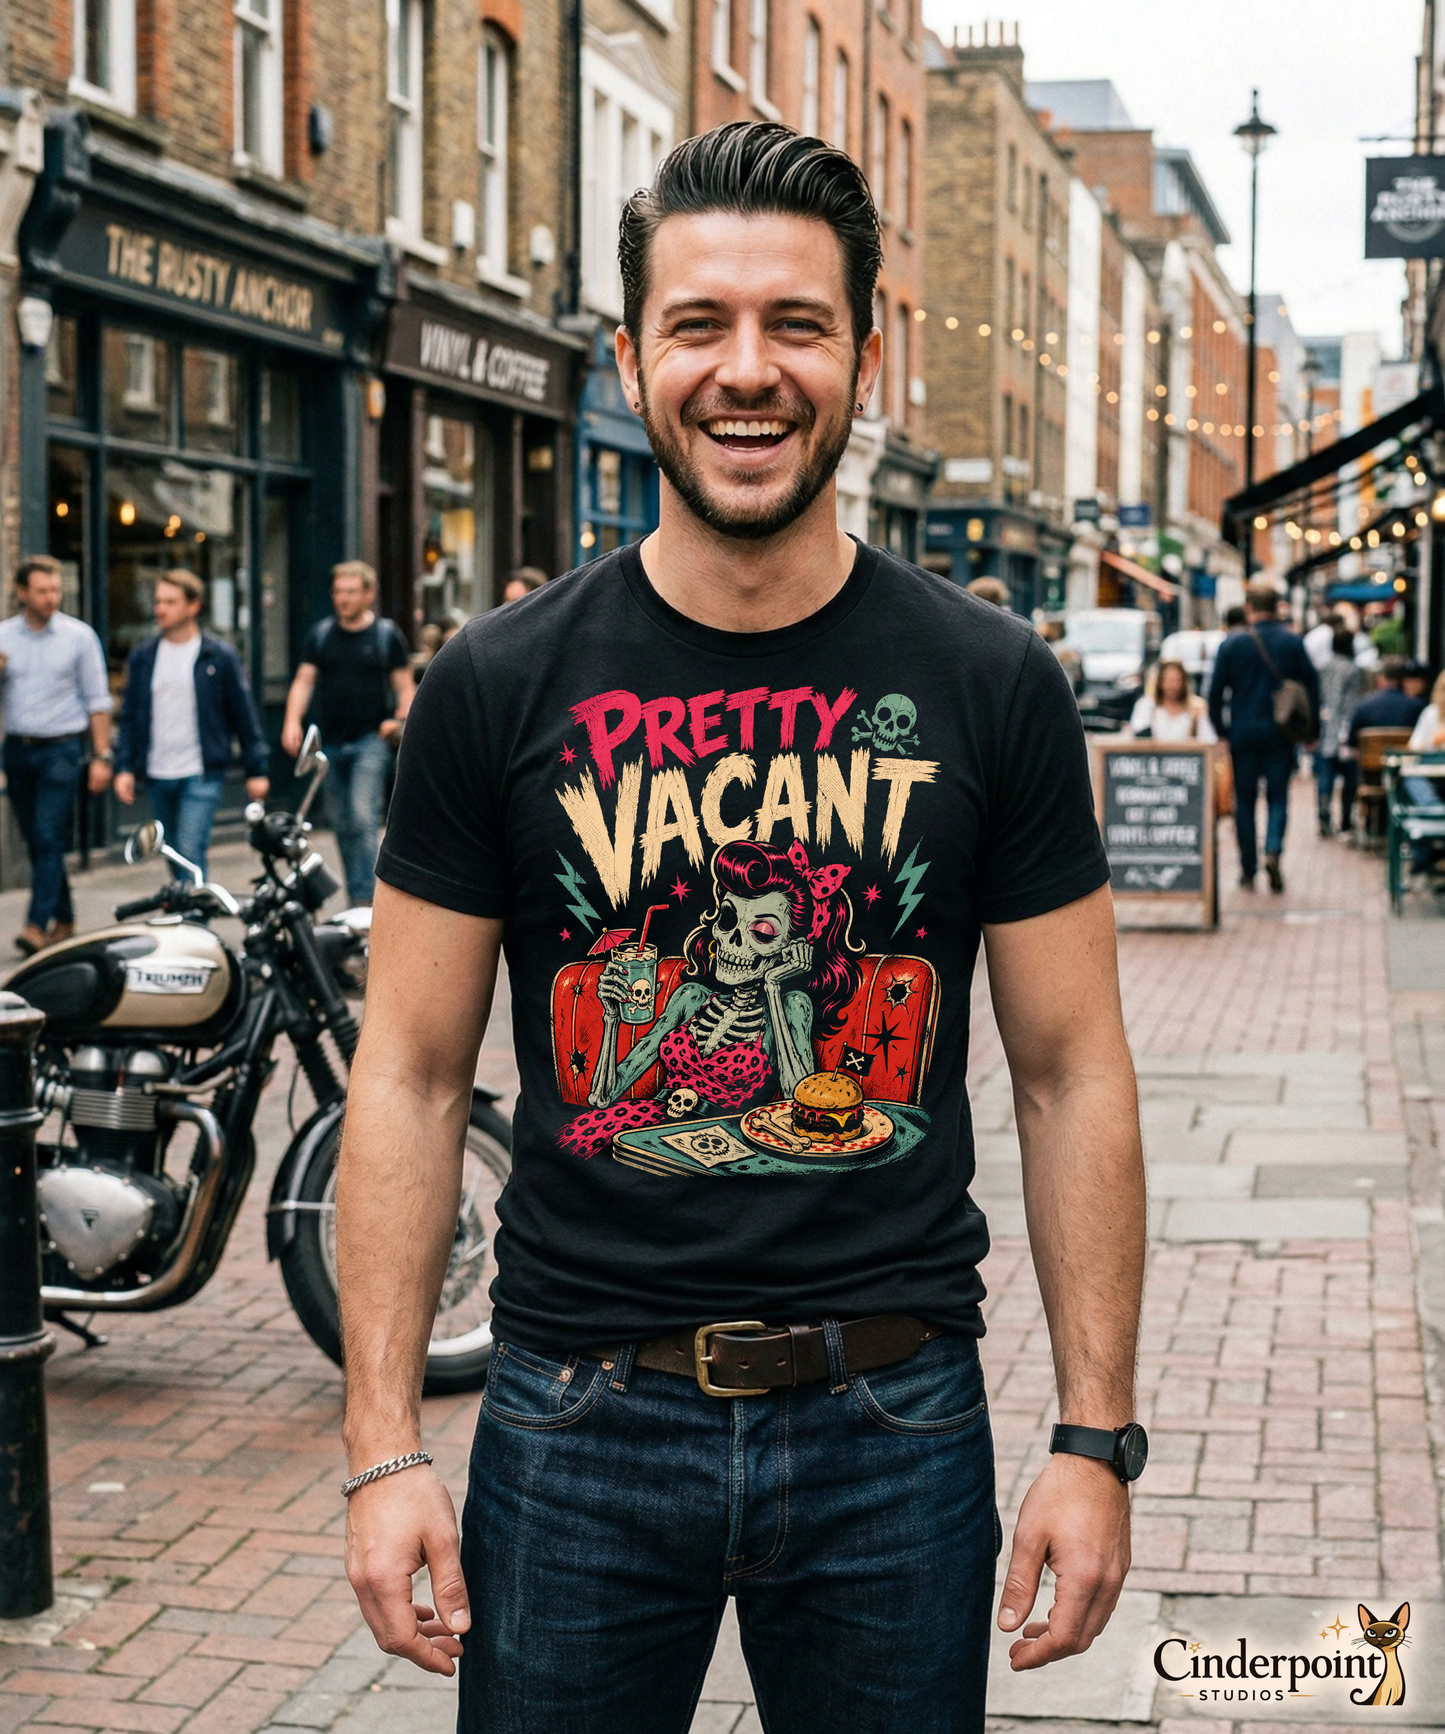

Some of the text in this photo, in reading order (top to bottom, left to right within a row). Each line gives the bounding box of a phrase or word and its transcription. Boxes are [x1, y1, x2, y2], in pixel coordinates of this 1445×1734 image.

[106, 223, 314, 331] THE RUSTY ANCHOR
[421, 319, 550, 401] VINYL & COFFEE
[568, 686, 858, 790] PRETTY
[554, 746, 941, 911] VACANT
[137, 971, 203, 985] TRIUMPH
